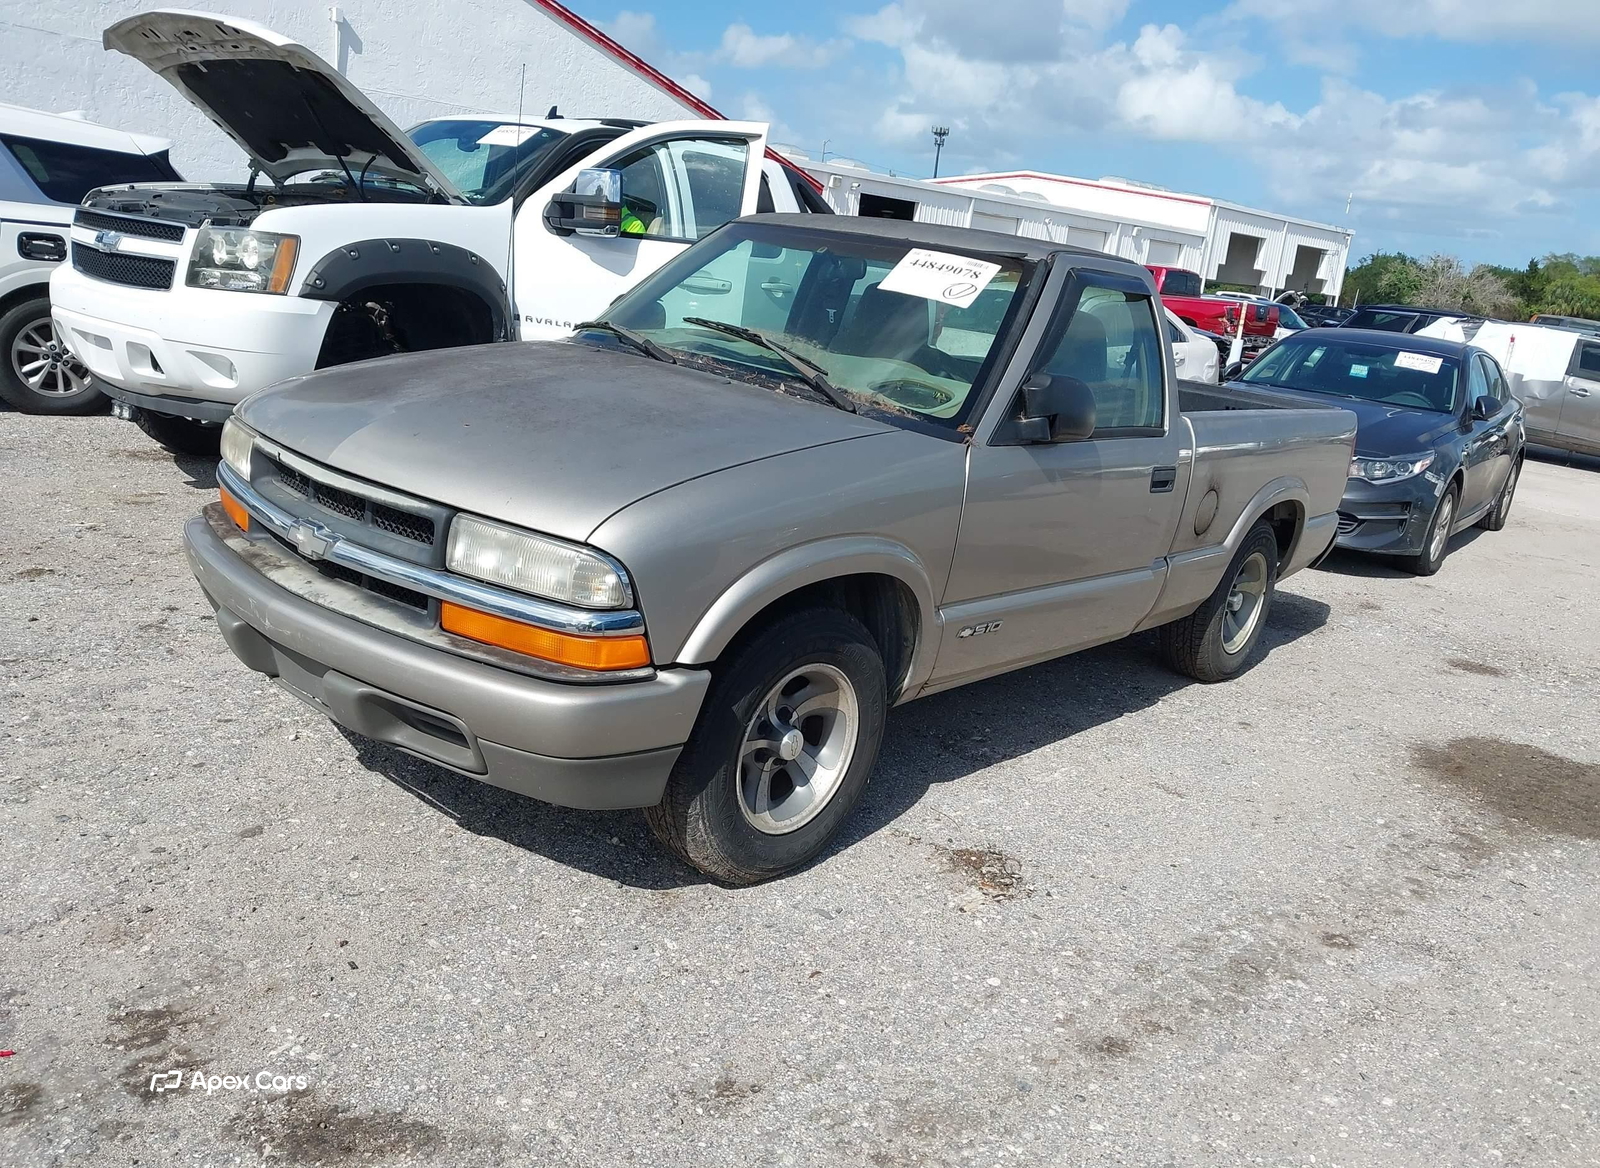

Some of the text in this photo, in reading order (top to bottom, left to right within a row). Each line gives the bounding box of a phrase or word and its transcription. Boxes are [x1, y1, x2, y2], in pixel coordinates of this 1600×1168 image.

[909, 258, 982, 280] 44849078
[525, 315, 578, 329] AVALA
[973, 620, 1004, 636] S10
